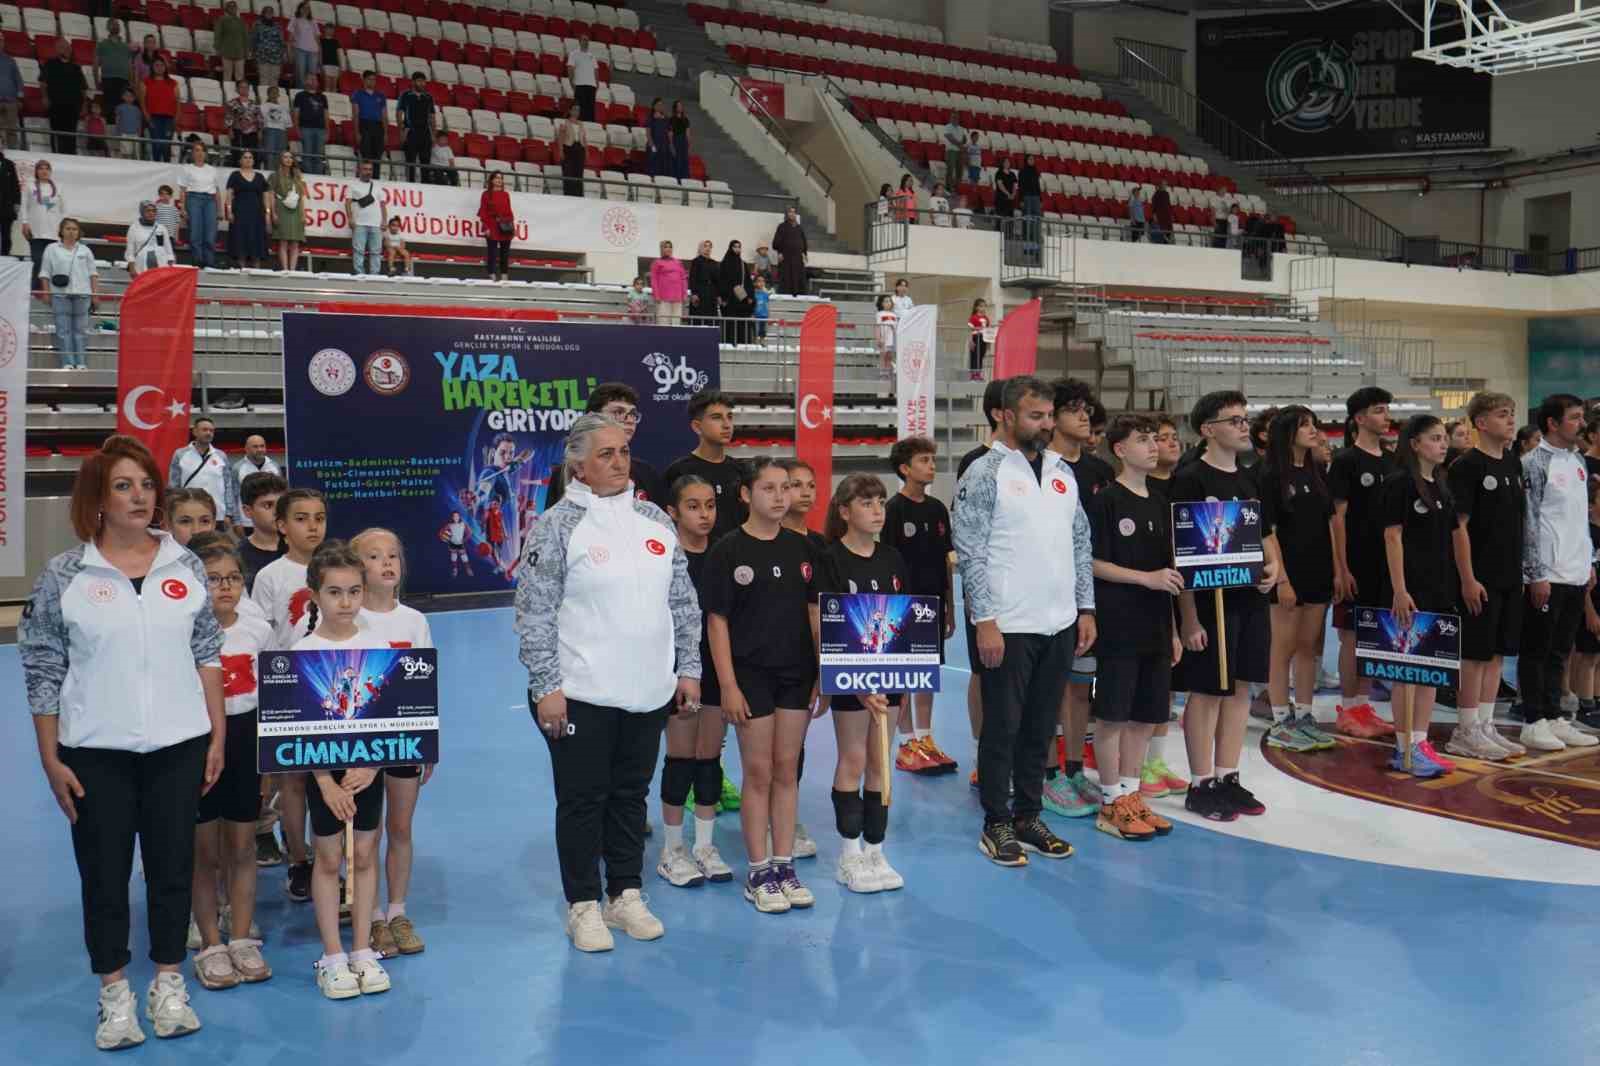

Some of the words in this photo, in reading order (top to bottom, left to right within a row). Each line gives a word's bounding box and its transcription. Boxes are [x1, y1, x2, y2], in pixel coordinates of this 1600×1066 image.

[1354, 98, 1423, 129] YERDE
[1416, 132, 1485, 144] KASTAMONU
[304, 208, 347, 229] SPO
[399, 213, 529, 241] MÜDÜRLÜ
[474, 334, 524, 342] KASTAMONU
[434, 351, 518, 382] YAZA
[488, 408, 585, 432] GİRİYOR
[1193, 565, 1252, 588] ATLETİZM
[835, 672, 933, 694] OKÇULUK
[1365, 662, 1450, 686] BASKETBOL
[275, 733, 423, 766] CİMNASTİK
